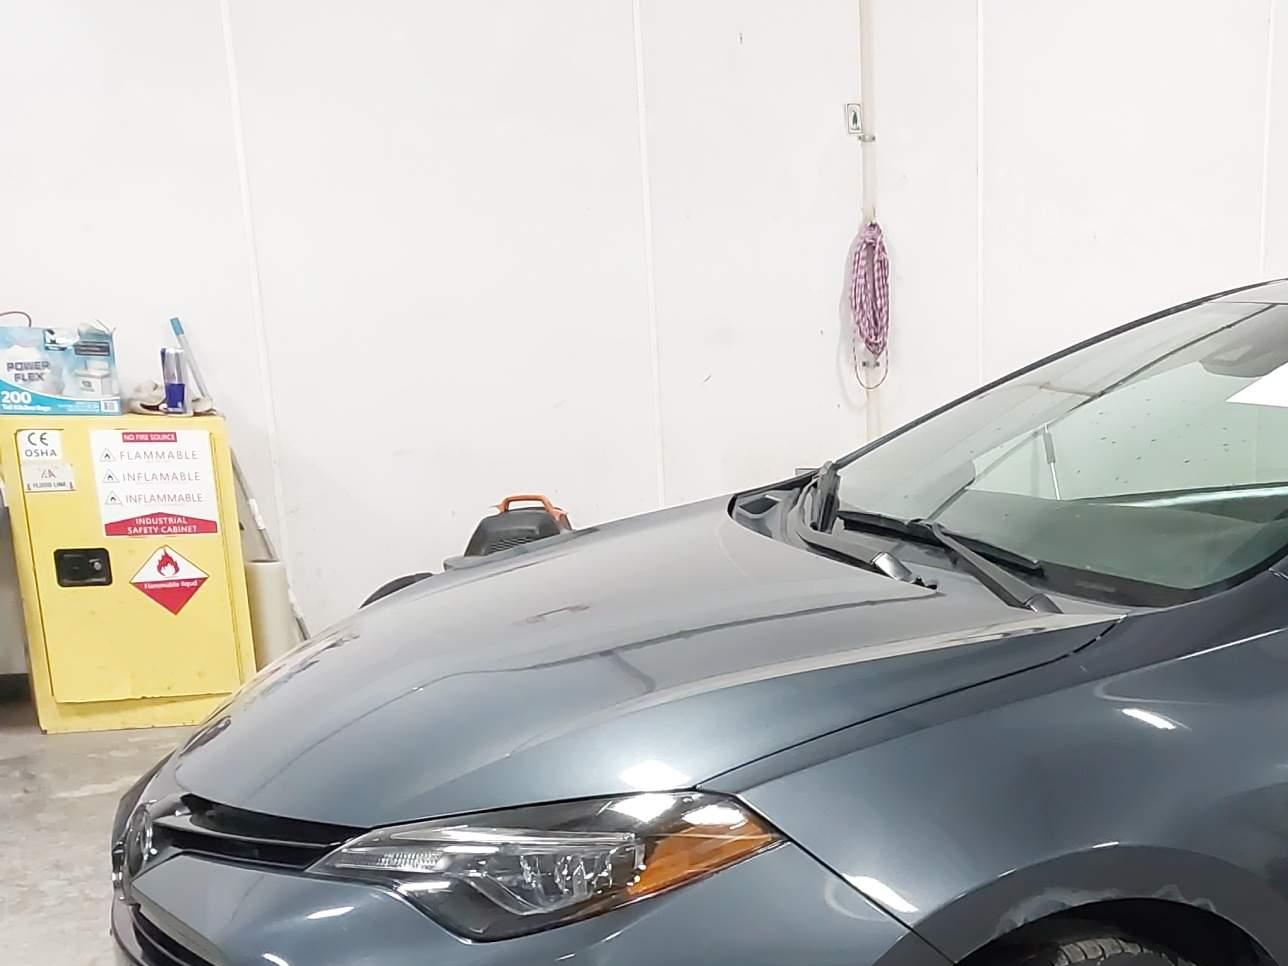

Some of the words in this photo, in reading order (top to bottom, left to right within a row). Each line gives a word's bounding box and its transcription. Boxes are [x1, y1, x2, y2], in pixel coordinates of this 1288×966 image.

[7, 361, 50, 372] POWER
[14, 372, 45, 382] FLEX
[0, 391, 32, 404] 200
[27, 432, 49, 446] CE
[123, 433, 135, 441] NO
[136, 433, 149, 441] FIRE
[150, 433, 175, 441] SOURCE
[25, 449, 57, 457] OSHA
[120, 450, 200, 461] FLAMMABLE
[122, 471, 200, 482] INFLAMABLE
[126, 493, 204, 504] INFLAMMABLE
[135, 516, 188, 525] INDUSTRIAL
[127, 526, 158, 534] SAFETY
[161, 525, 197, 533] CABINET
